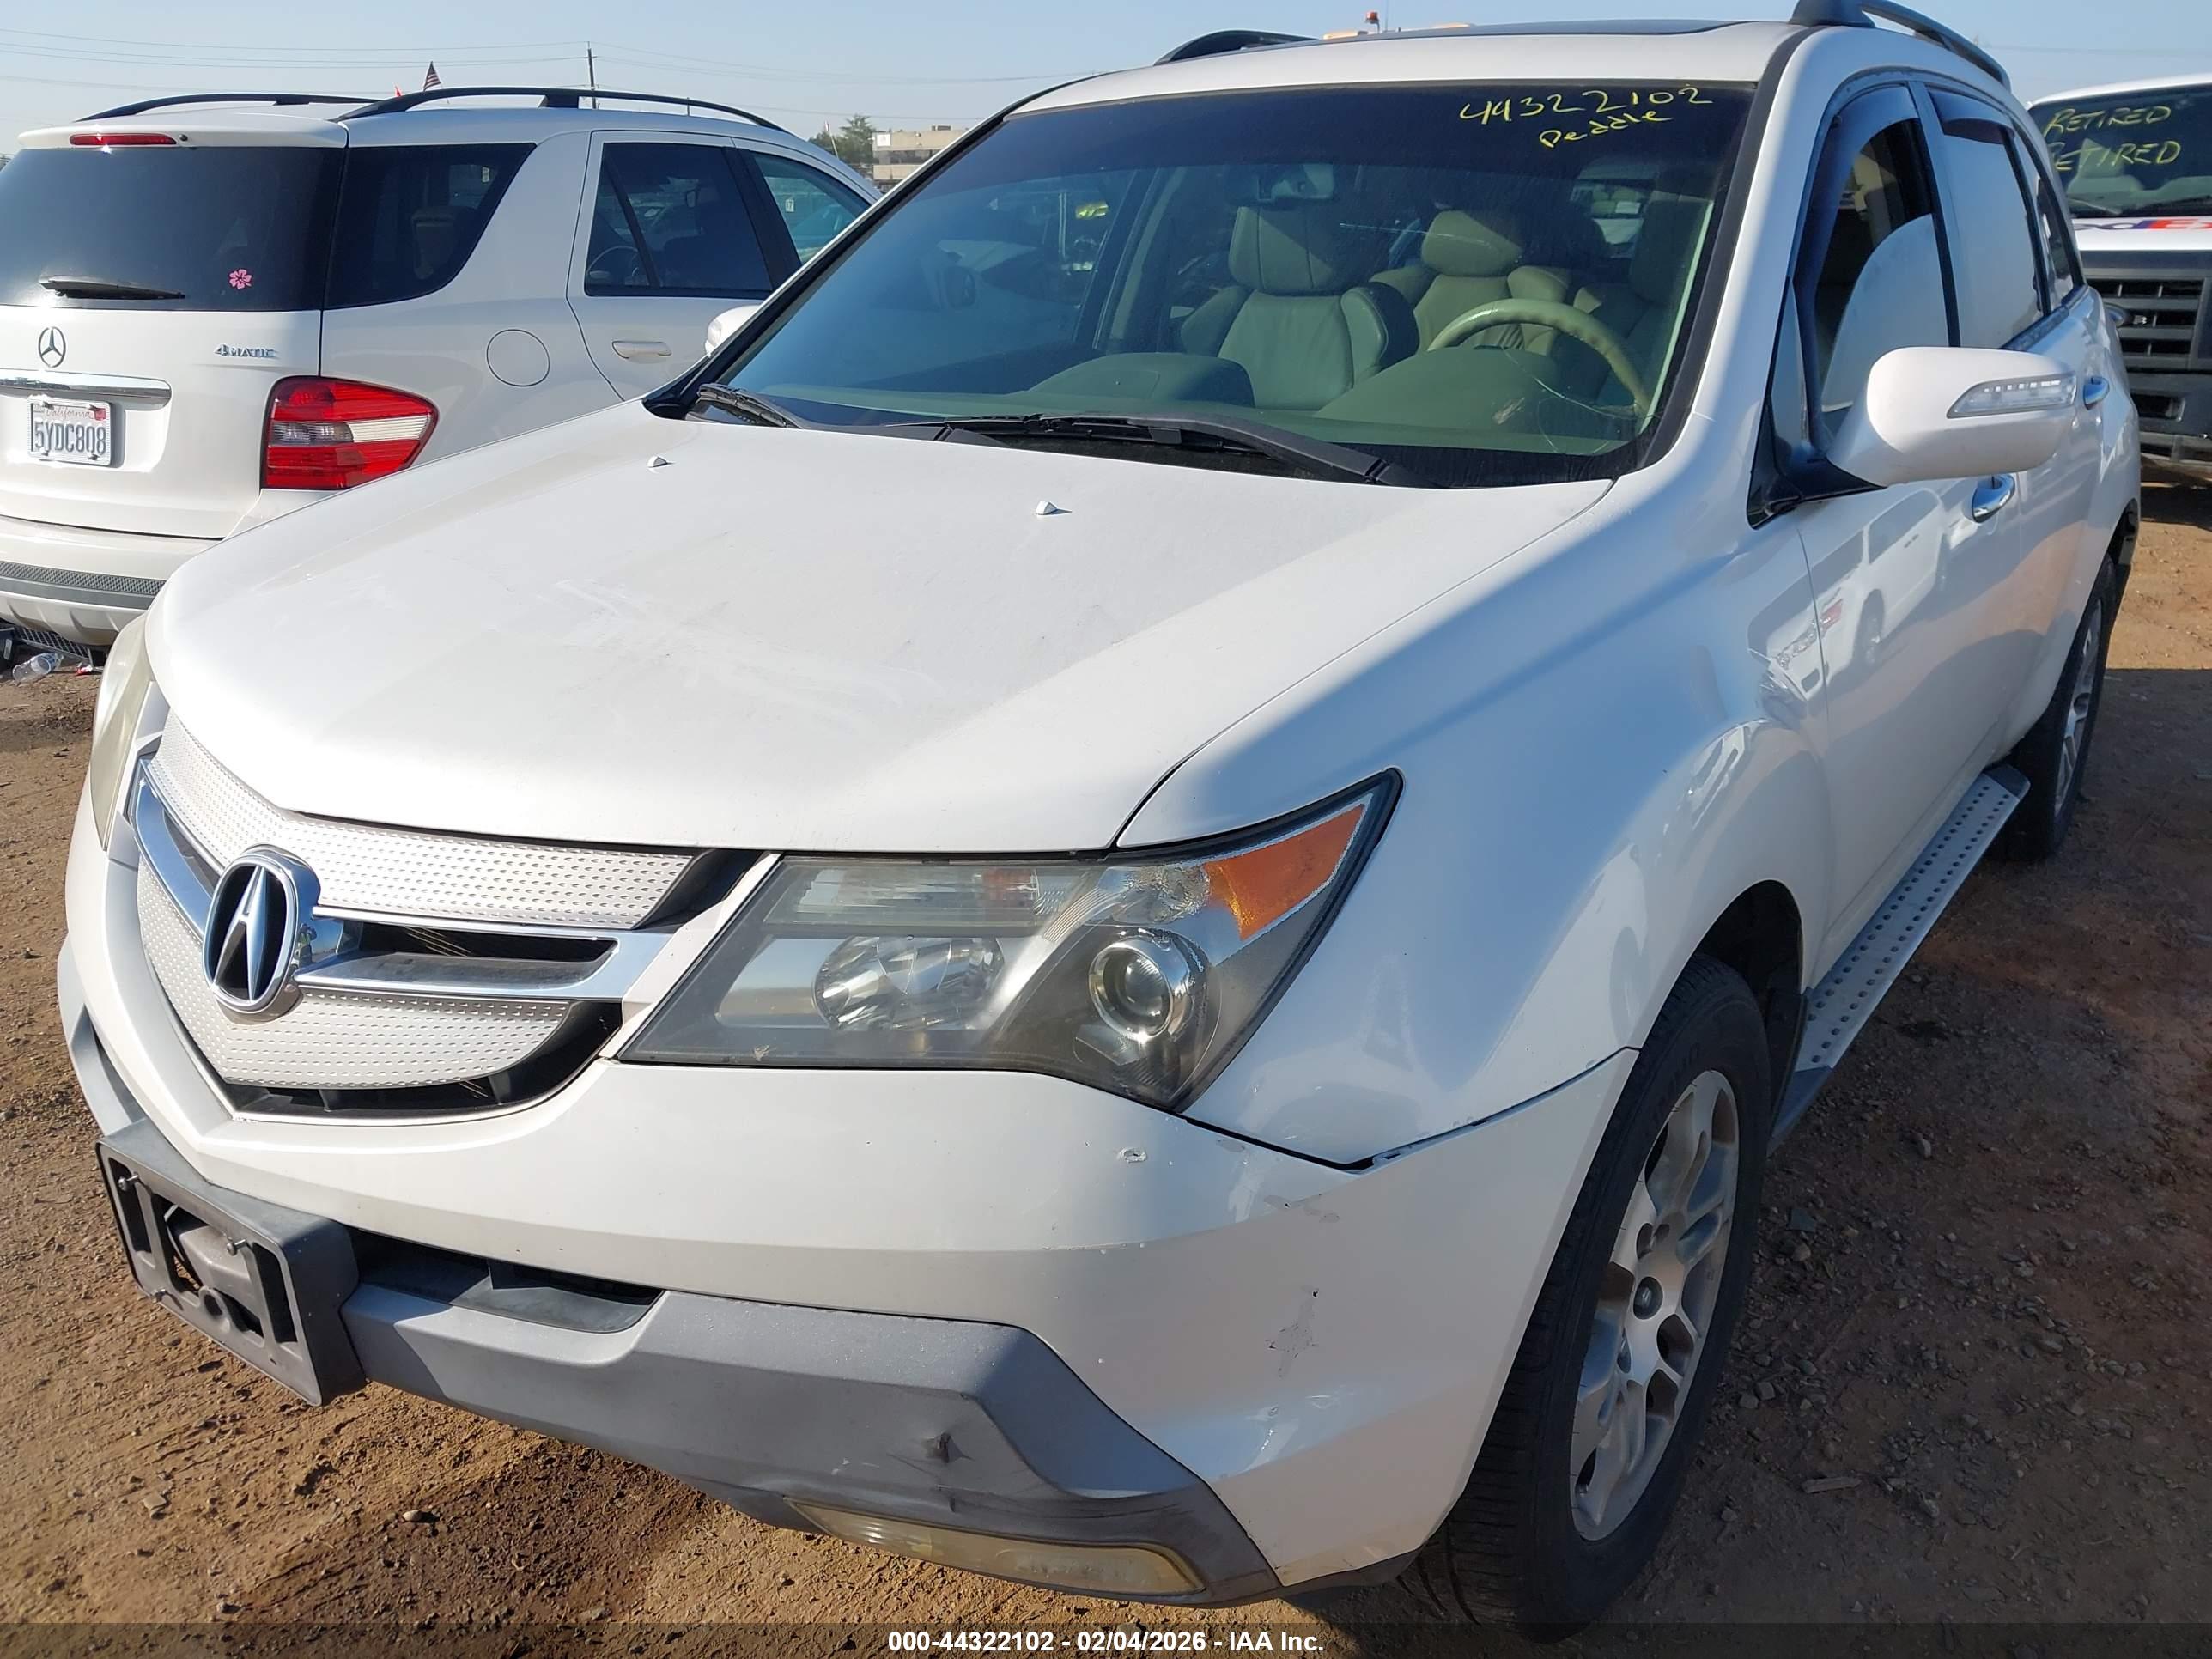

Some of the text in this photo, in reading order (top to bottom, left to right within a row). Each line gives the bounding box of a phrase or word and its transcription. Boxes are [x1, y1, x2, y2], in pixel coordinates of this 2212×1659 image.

[2044, 106, 2172, 138] RETIRED
[213, 343, 277, 358] 4MATIC
[34, 420, 106, 455] 5YDC808
